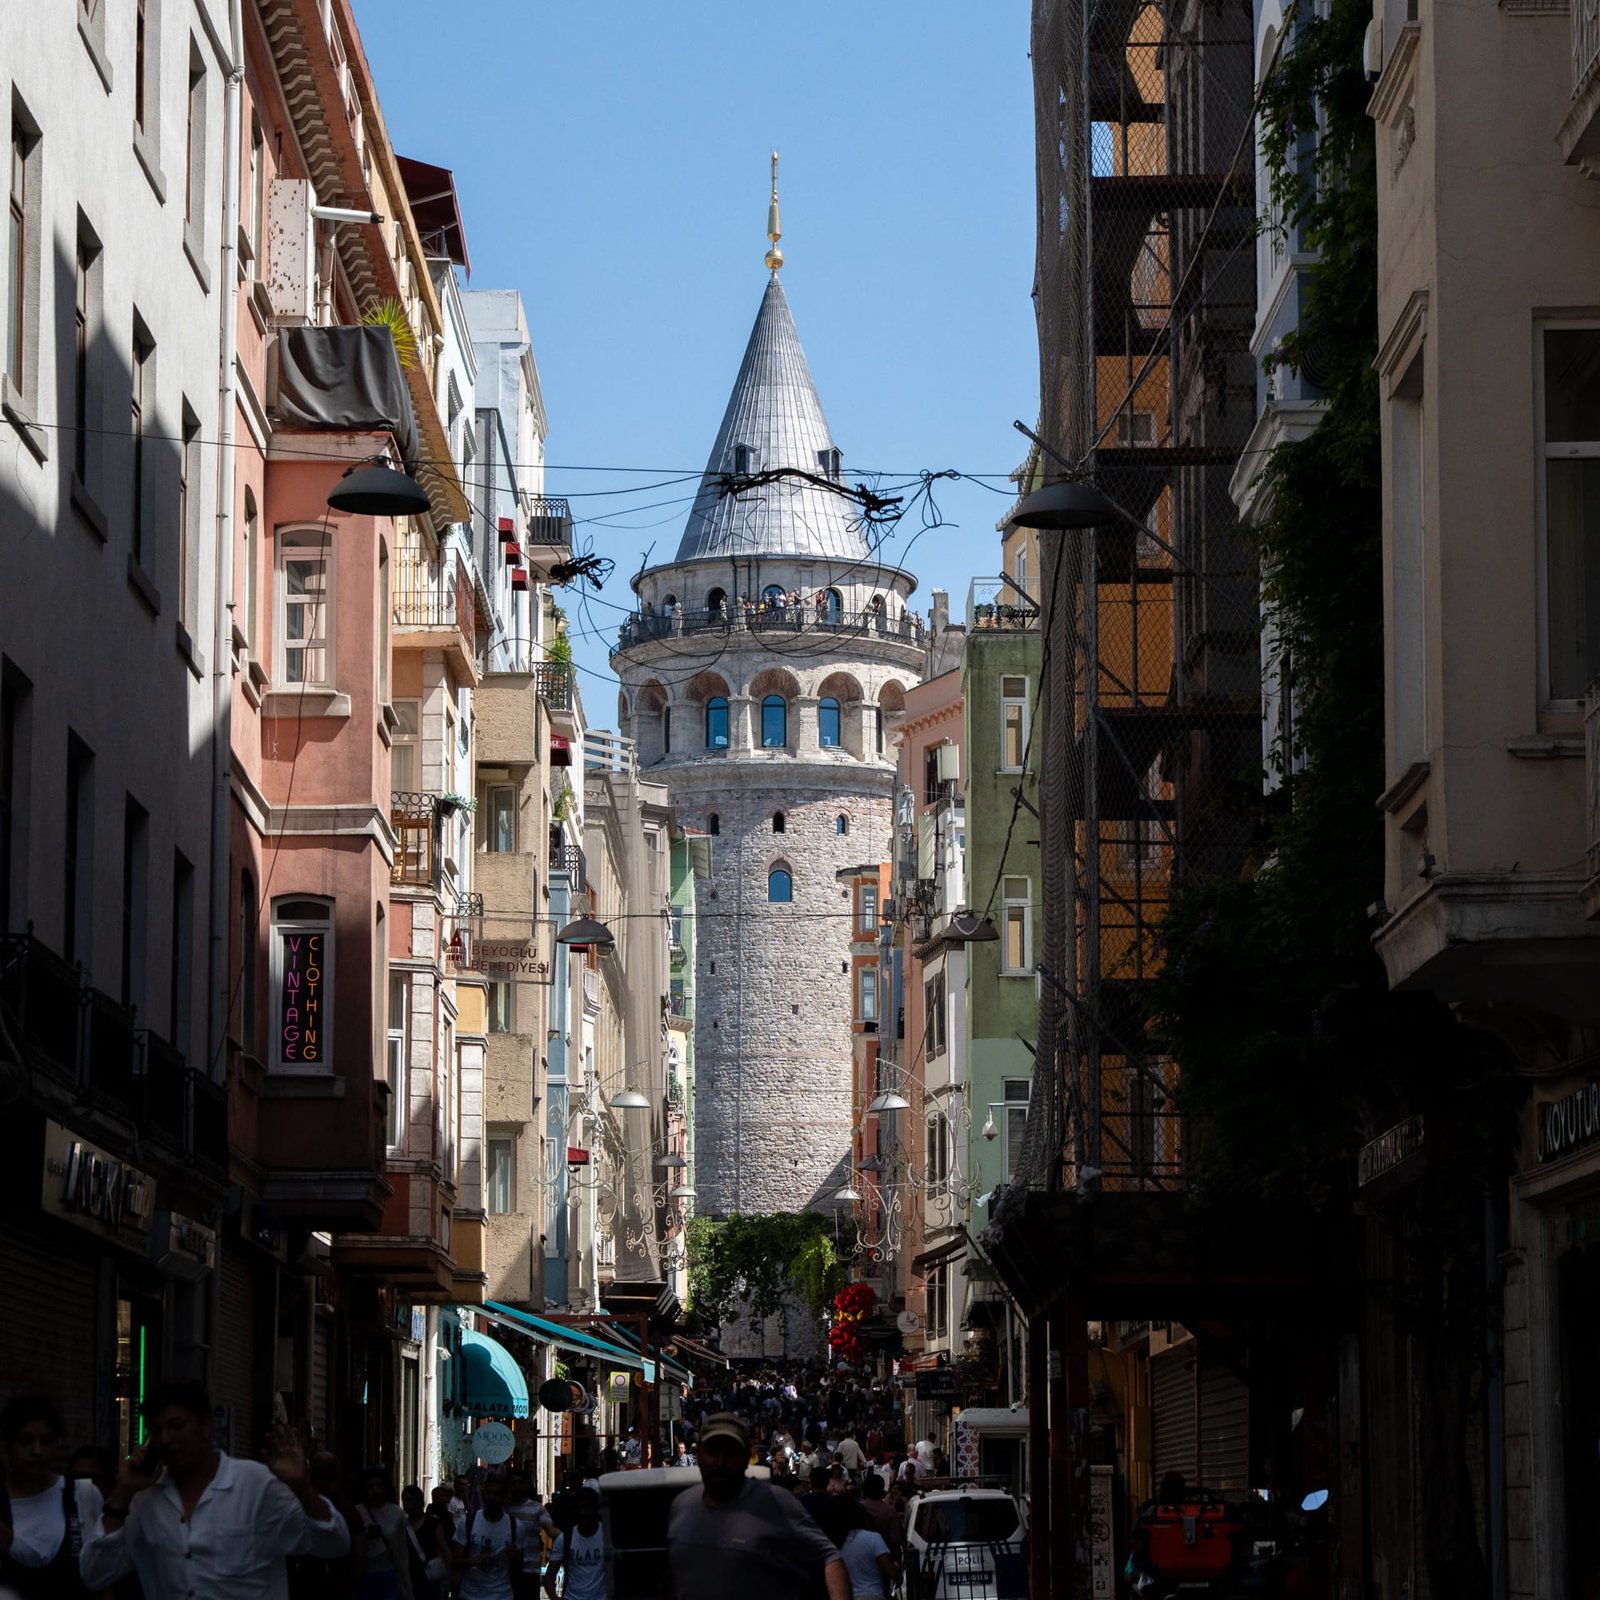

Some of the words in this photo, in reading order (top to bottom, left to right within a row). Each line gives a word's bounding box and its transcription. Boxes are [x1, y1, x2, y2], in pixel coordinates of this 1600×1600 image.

[284, 936, 301, 1060] VINTAGE
[303, 936, 320, 1060] CLOTHING
[471, 960, 549, 974] BELEDİYESİ
[477, 1431, 510, 1441] MOON
